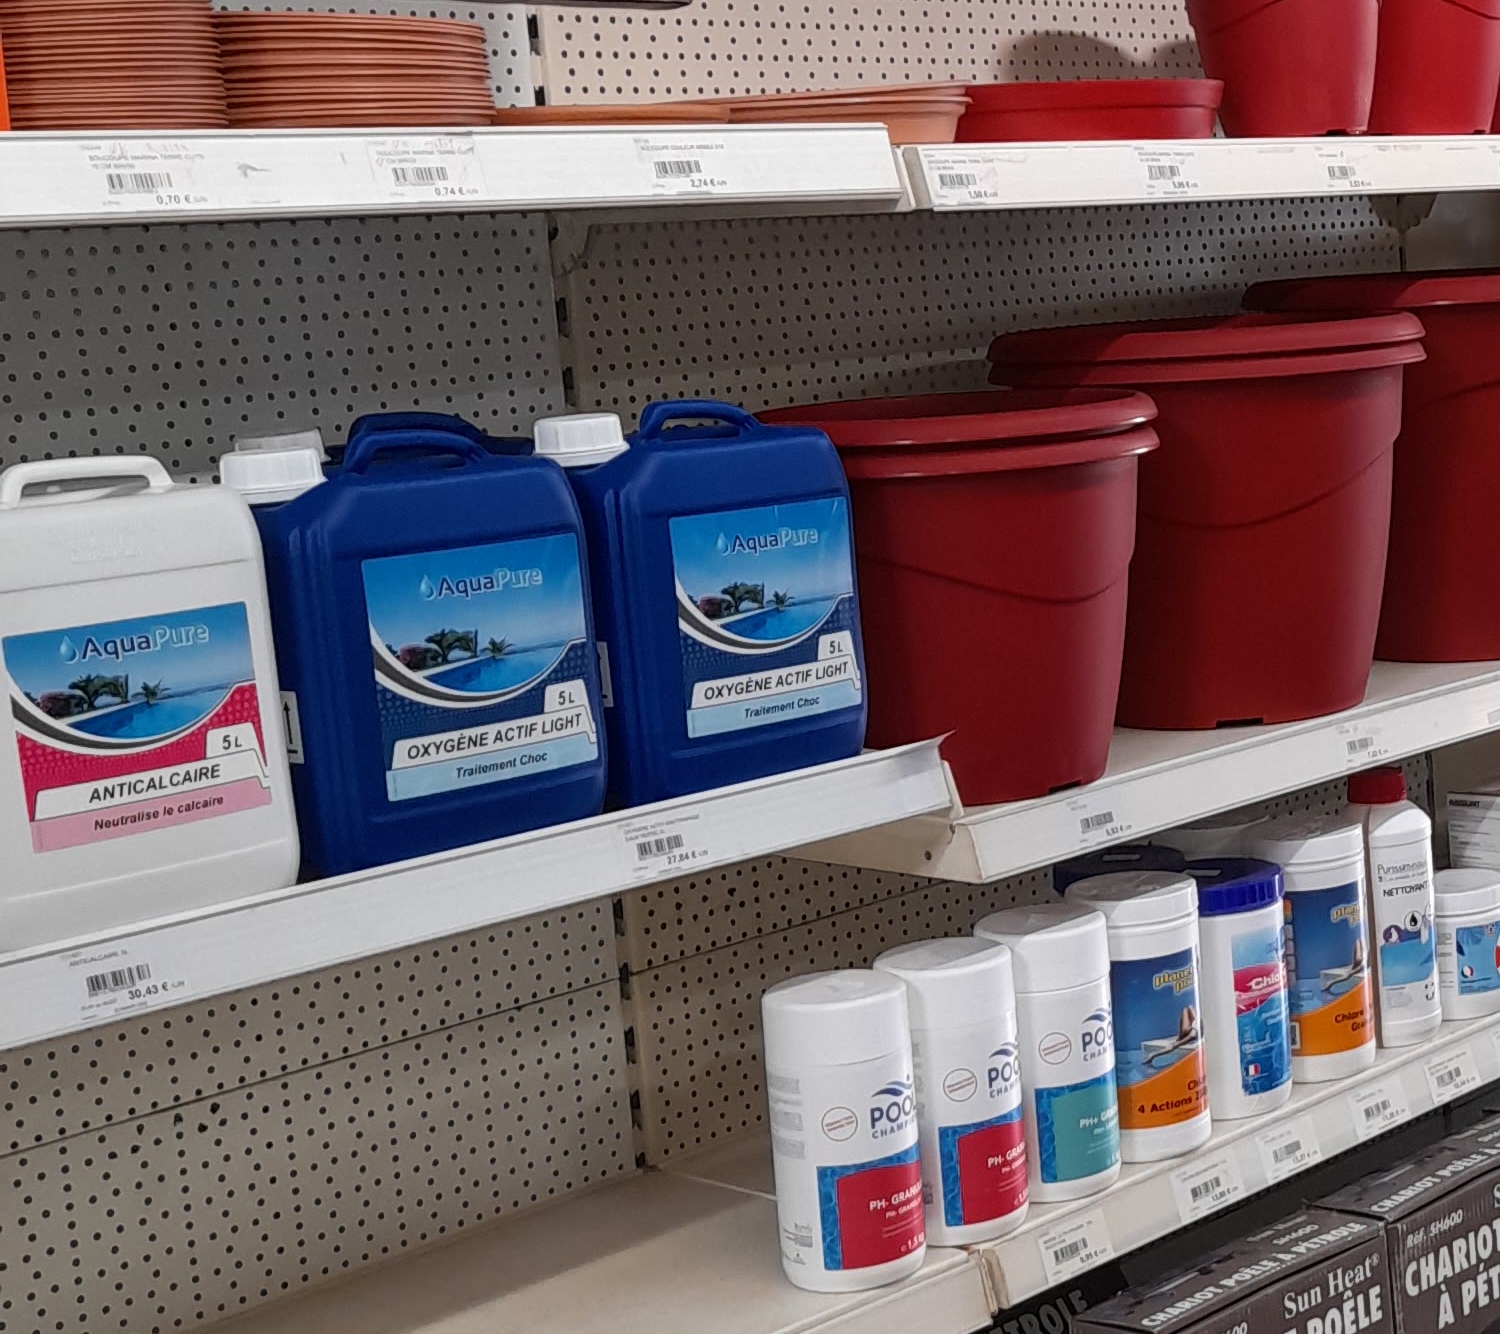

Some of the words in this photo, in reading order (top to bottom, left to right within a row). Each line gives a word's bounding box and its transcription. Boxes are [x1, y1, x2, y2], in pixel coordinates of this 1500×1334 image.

[156, 194, 180, 205] 0,70
[184, 193, 191, 204] €
[732, 527, 819, 555] AquaPure
[438, 567, 542, 599] AquaPure
[82, 624, 208, 662] AquaPure
[829, 640, 836, 654] 5
[837, 642, 843, 653] L
[704, 677, 772, 700] OXYGÈNE
[775, 668, 812, 689] ACTIF
[815, 661, 848, 679] LIGHT
[558, 690, 566, 705] 5
[568, 692, 575, 704] L
[744, 700, 795, 718] Traitement
[797, 696, 820, 709] Choc
[222, 734, 231, 750] 5
[234, 736, 242, 748] L
[408, 732, 488, 759] OXYGÈNE
[494, 722, 537, 745] ACTIF
[542, 713, 582, 735] LIGHT
[456, 758, 516, 779] Traitement
[520, 752, 547, 766] Choc
[89, 764, 220, 802] ANTICALCAIRE
[95, 810, 159, 830] Neutralise
[163, 805, 173, 816] le
[178, 795, 224, 814] calcaire
[128, 984, 158, 1000] 30,43
[162, 981, 168, 992] €
[1138, 1104, 1145, 1114] 4
[1150, 1097, 1193, 1114] Actions
[1371, 1176, 1441, 1212] CHARIOT
[1435, 1154, 1484, 1182] POÊLE
[1407, 1231, 1427, 1249] Réf.
[1430, 1209, 1463, 1237] SH600
[1141, 1285, 1223, 1328] CHARIOT
[1220, 1259, 1278, 1289] POÊLE
[1292, 1221, 1367, 1254] PÉTROLE
[1283, 1289, 1322, 1319] Sun
[1438, 1284, 1454, 1330] À
